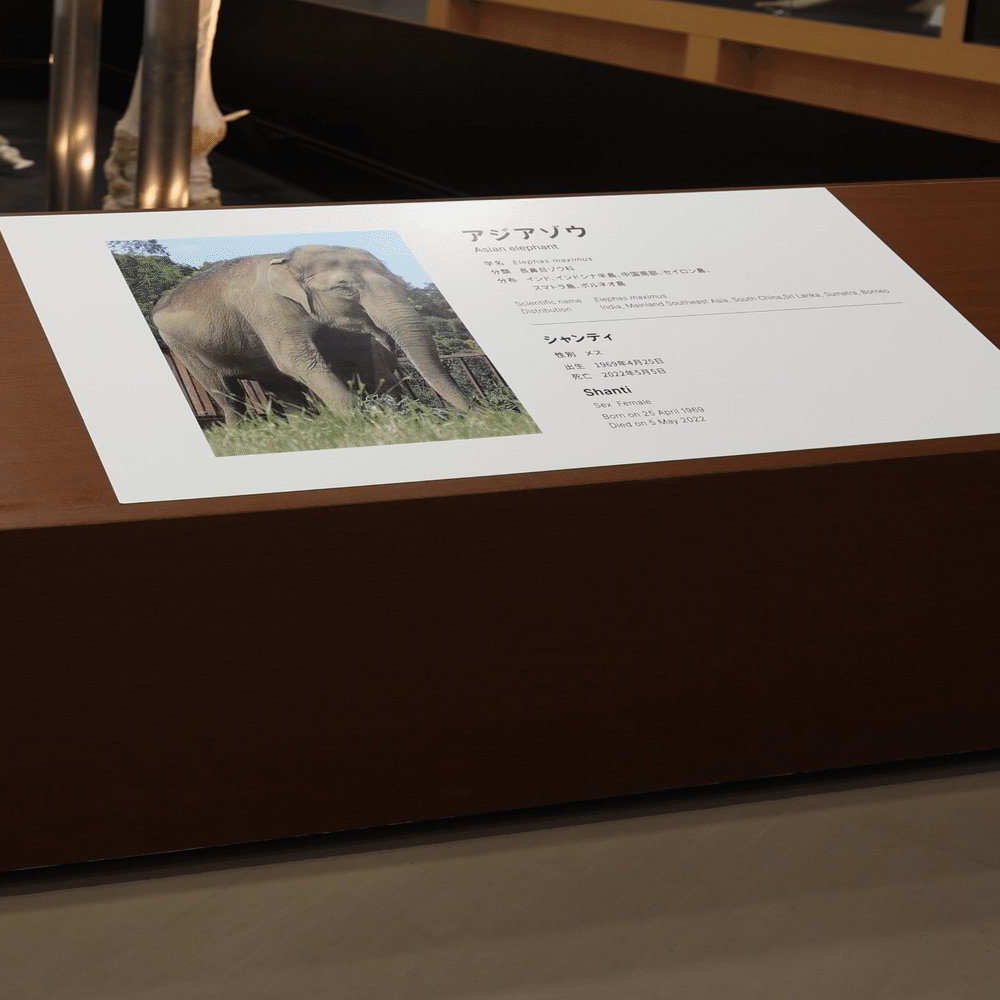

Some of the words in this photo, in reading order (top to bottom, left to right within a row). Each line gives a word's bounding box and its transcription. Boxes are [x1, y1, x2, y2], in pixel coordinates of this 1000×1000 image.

[462, 225, 587, 242] アジアゾウ
[474, 245, 507, 253] Asian
[509, 243, 559, 253] elephant
[515, 299, 556, 307] Scientific
[594, 295, 628, 303] Elephas
[520, 306, 572, 315] Distribution
[625, 301, 665, 309] Mainland
[544, 332, 613, 345] シャンティ
[554, 350, 576, 358] 性別
[594, 357, 664, 369] 1969年4月25日
[571, 372, 593, 380] 死亡
[601, 367, 667, 378] 2022年5月5日
[583, 385, 632, 397] Shanti
[593, 401, 612, 409] Sex
[616, 399, 652, 407] Female
[601, 411, 626, 420] Born
[642, 409, 656, 417] 25
[658, 407, 680, 416] April
[681, 405, 705, 414] 1969
[608, 419, 633, 429] Died
[634, 419, 647, 427] on
[649, 418, 657, 426] 5
[658, 416, 679, 427] May
[680, 415, 707, 424] 2022
